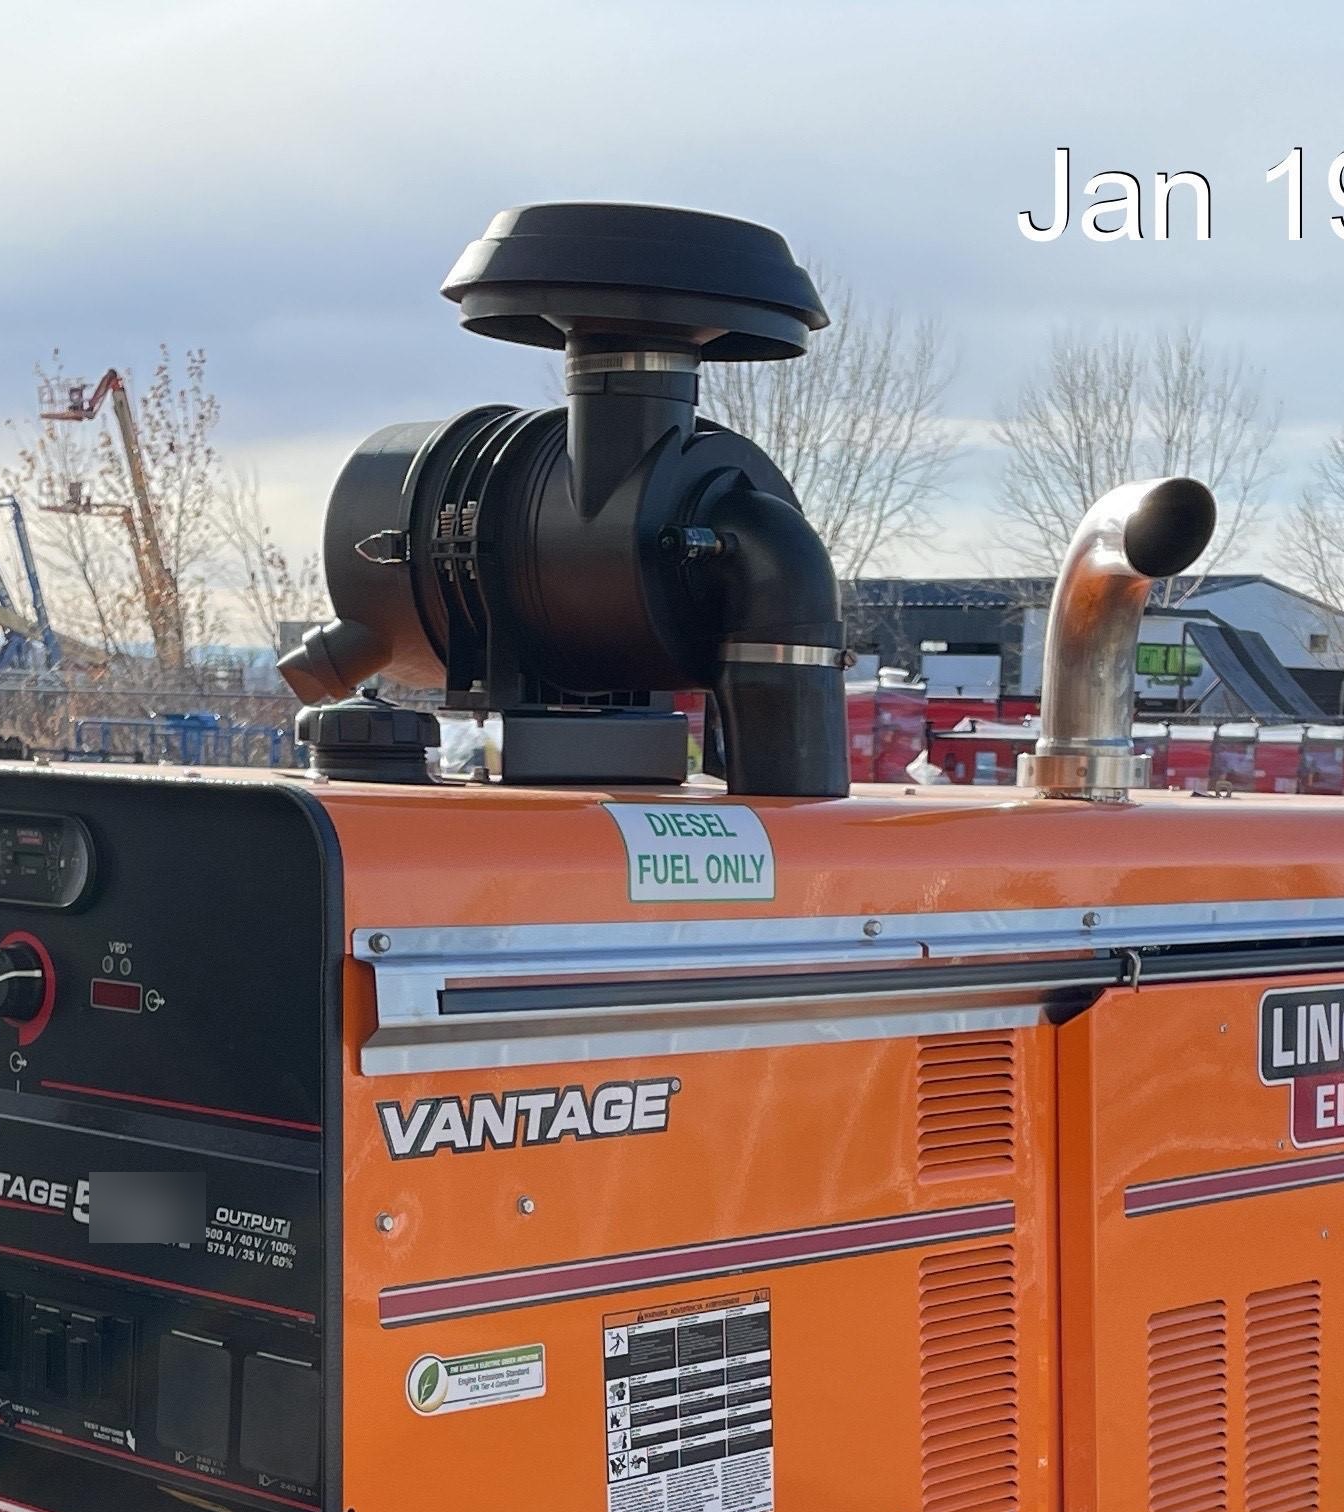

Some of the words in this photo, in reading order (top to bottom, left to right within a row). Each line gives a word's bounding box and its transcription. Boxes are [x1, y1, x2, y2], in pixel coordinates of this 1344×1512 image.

[644, 812, 737, 837] DIESEL
[637, 854, 698, 884] FUEL
[706, 854, 765, 883] ONLY
[383, 1082, 671, 1157] VANTAGE
[215, 1207, 287, 1234] OUTPUT
[205, 1227, 223, 1241] 500
[223, 1230, 232, 1242] A
[240, 1234, 253, 1247] 40
[254, 1237, 262, 1248] V
[270, 1240, 297, 1255] 100%
[207, 1241, 225, 1255] 575
[226, 1245, 235, 1257] A
[242, 1248, 255, 1262] 35
[256, 1251, 265, 1264] V
